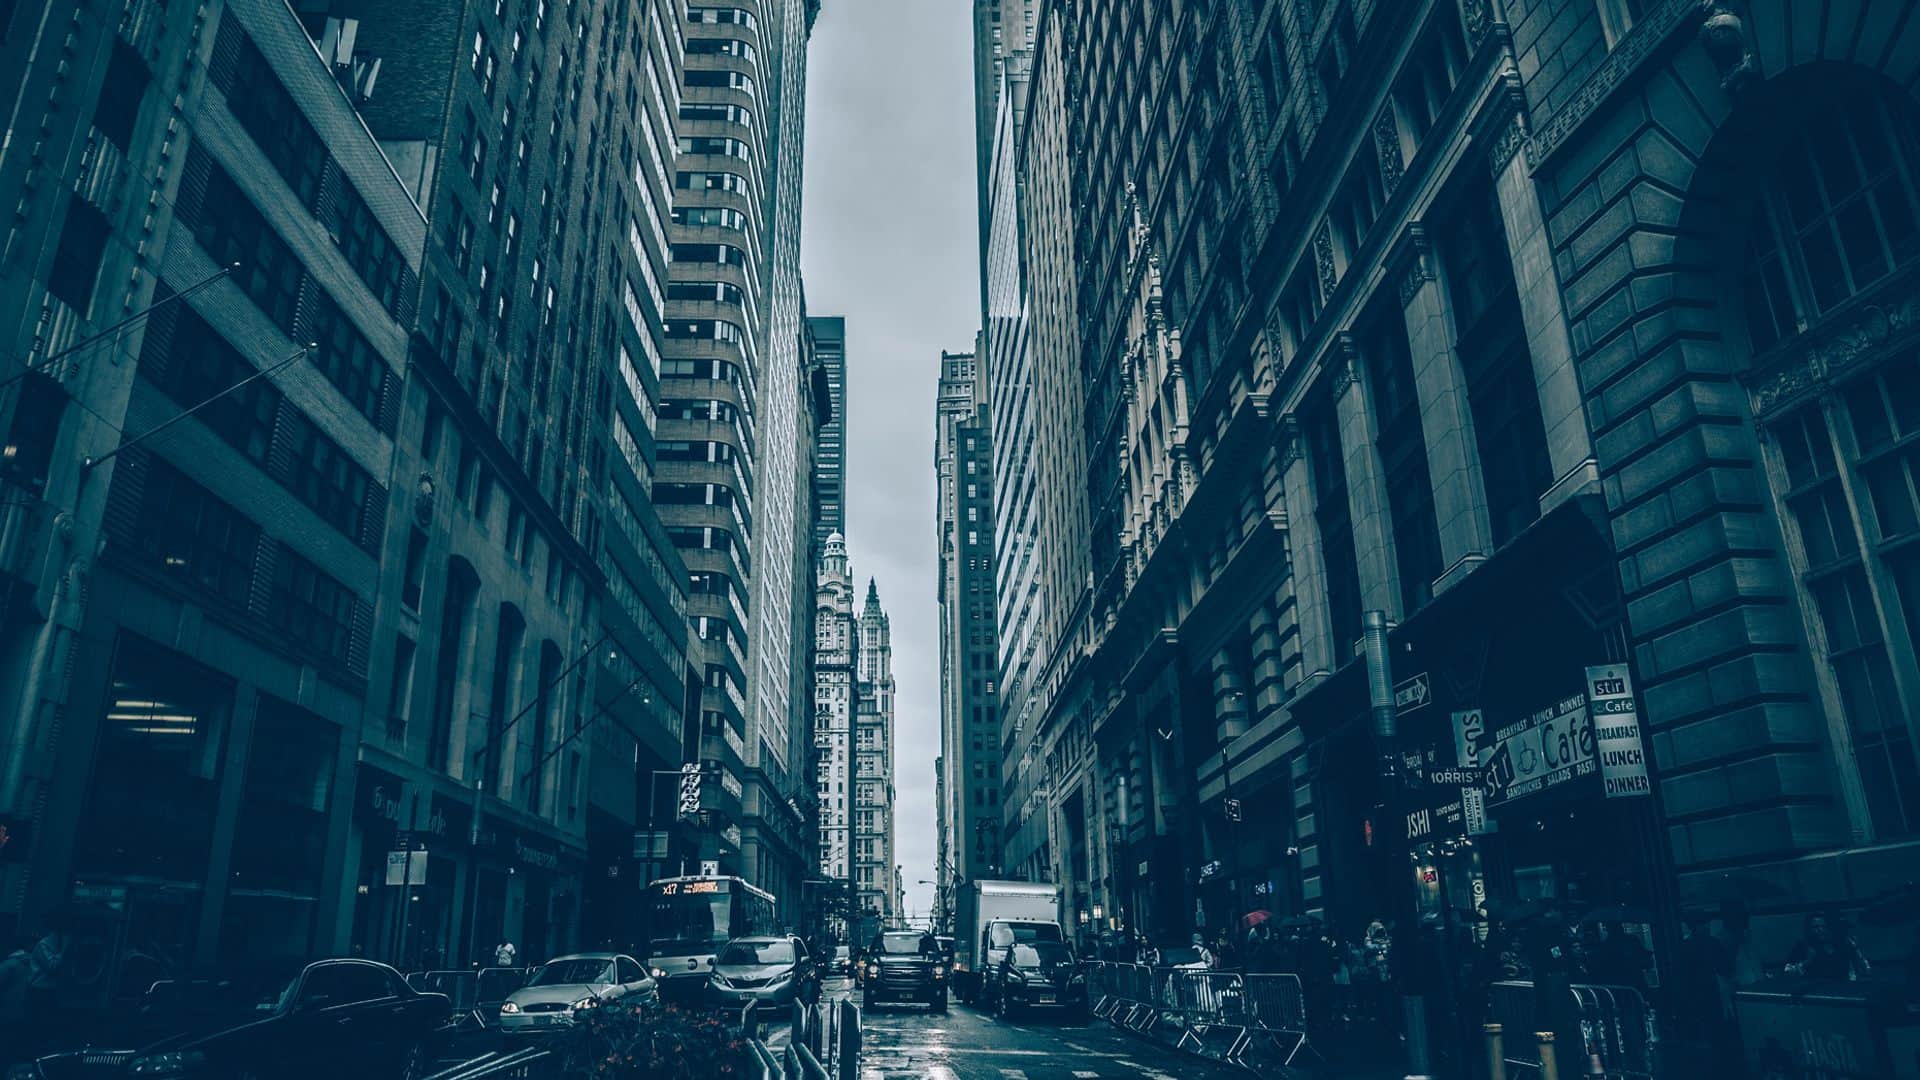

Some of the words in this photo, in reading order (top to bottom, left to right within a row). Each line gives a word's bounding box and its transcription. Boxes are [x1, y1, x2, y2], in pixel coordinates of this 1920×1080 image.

[1496, 718, 1528, 743] BREAKFAST
[1532, 706, 1554, 725] LUNCH
[1596, 725, 1639, 741] BREAKFAST
[1603, 750, 1642, 767] LUNCH
[1506, 778, 1542, 799] SANDWICHES
[1547, 767, 1572, 786] SALADS
[1606, 776, 1649, 793] DINNER
